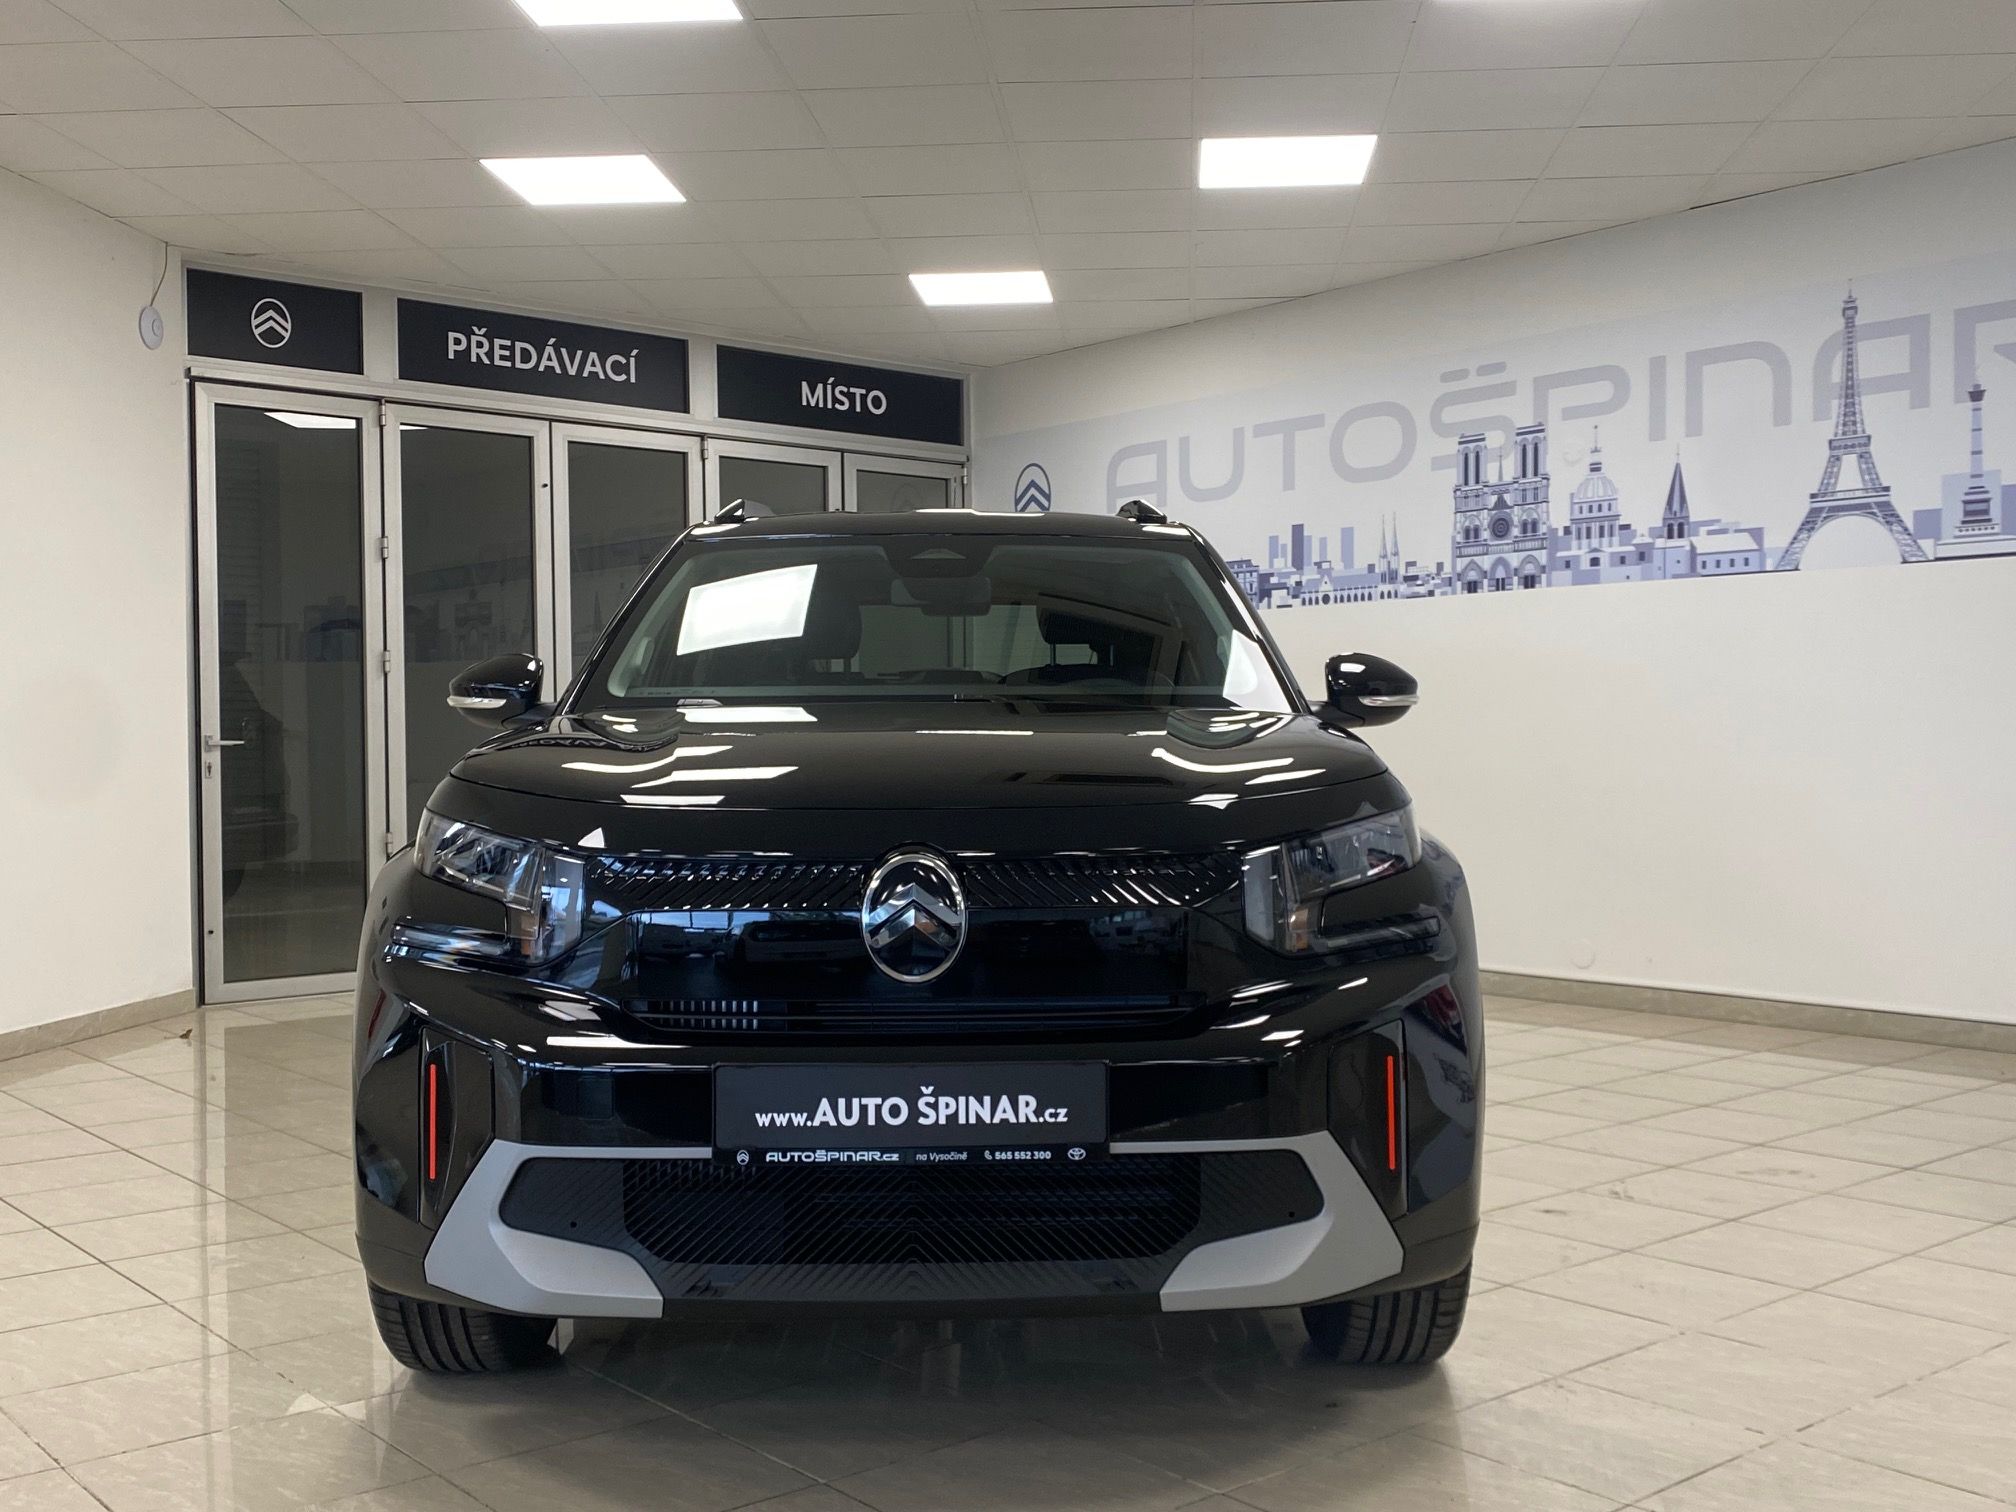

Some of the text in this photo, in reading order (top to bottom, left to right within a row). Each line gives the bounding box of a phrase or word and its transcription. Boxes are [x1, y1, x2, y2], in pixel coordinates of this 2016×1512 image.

[447, 326, 887, 415] PŘEDÁVACÍ MÍSTO
[755, 1086, 1068, 1127] www.AUTO ŠPINAR.cz
[916, 1153, 928, 1161] na
[929, 1152, 968, 1163] Vysočině
[995, 1151, 1013, 1160] 565
[1014, 1151, 1032, 1160] 552
[1033, 1150, 1052, 1160] 300
